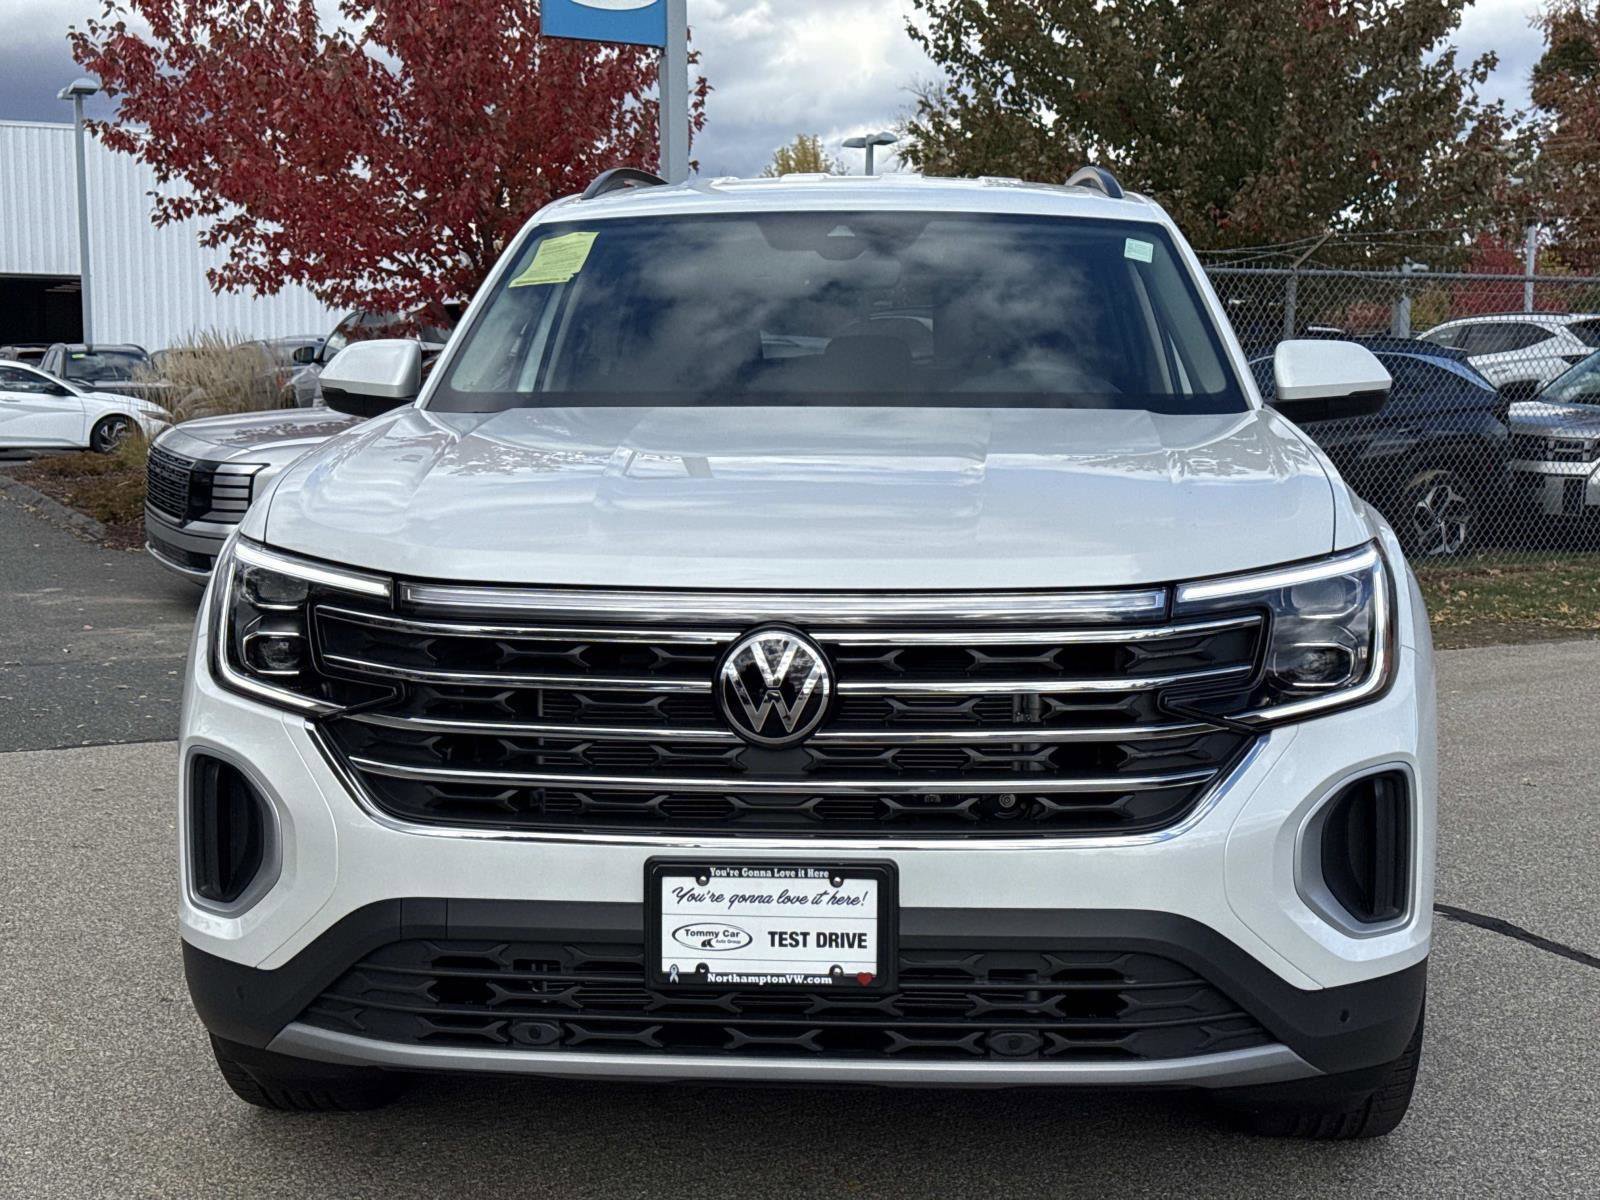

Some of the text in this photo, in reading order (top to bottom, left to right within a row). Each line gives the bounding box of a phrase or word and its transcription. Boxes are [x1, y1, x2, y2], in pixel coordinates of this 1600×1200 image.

[710, 867, 829, 878] You're Gonna Love it Here
[672, 886, 868, 910] You're gonna love it here!
[684, 929, 741, 938] Tommy Car
[768, 931, 867, 949] TEST DRIVE
[707, 973, 832, 985] NorthamptonVW.com
